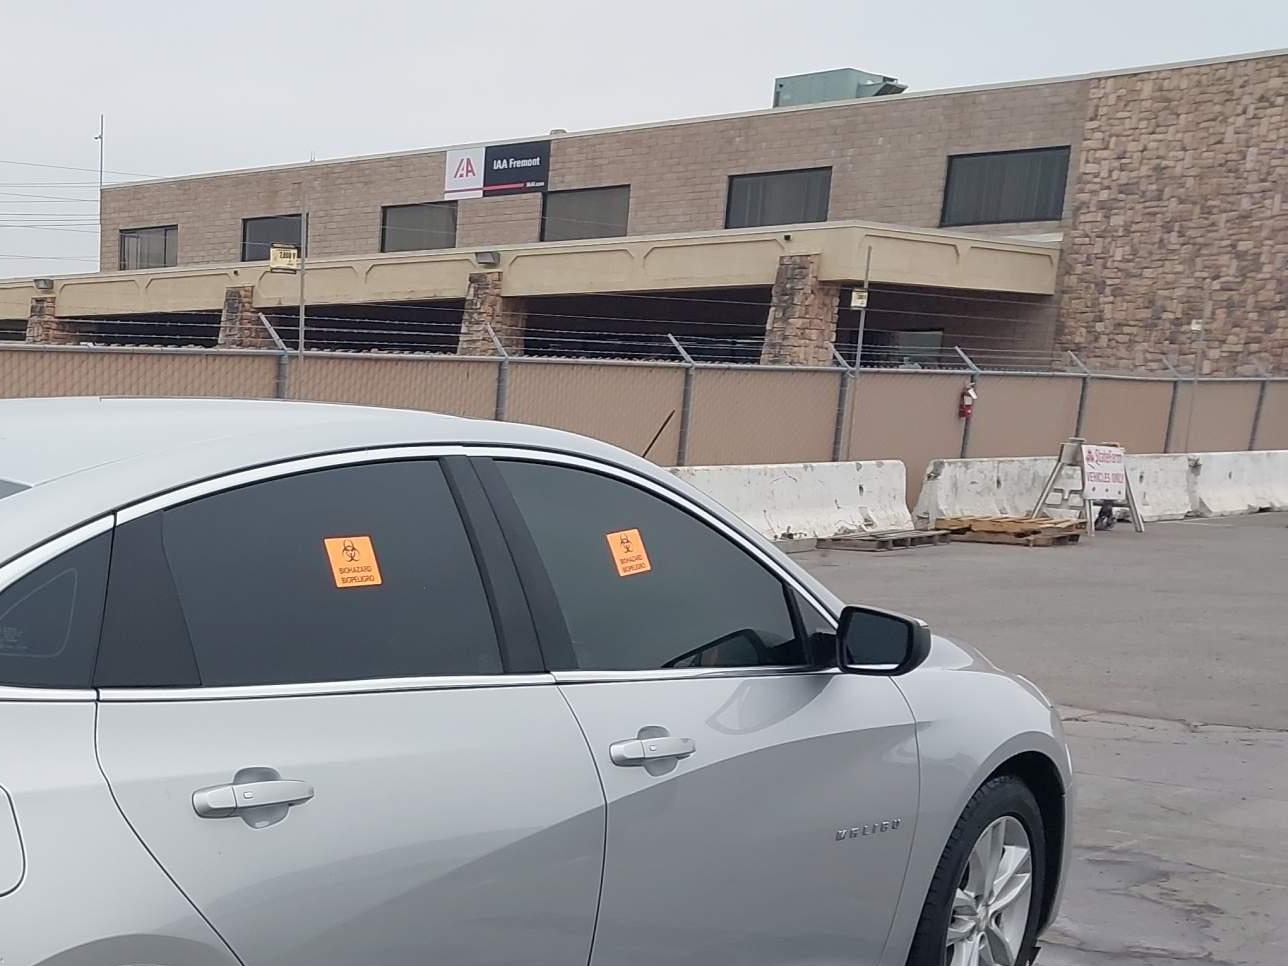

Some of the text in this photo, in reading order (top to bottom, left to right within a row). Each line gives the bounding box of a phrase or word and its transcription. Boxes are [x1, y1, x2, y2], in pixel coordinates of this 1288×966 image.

[493, 157, 541, 170] IAA Fremont
[338, 565, 372, 574] BIOHAZARD
